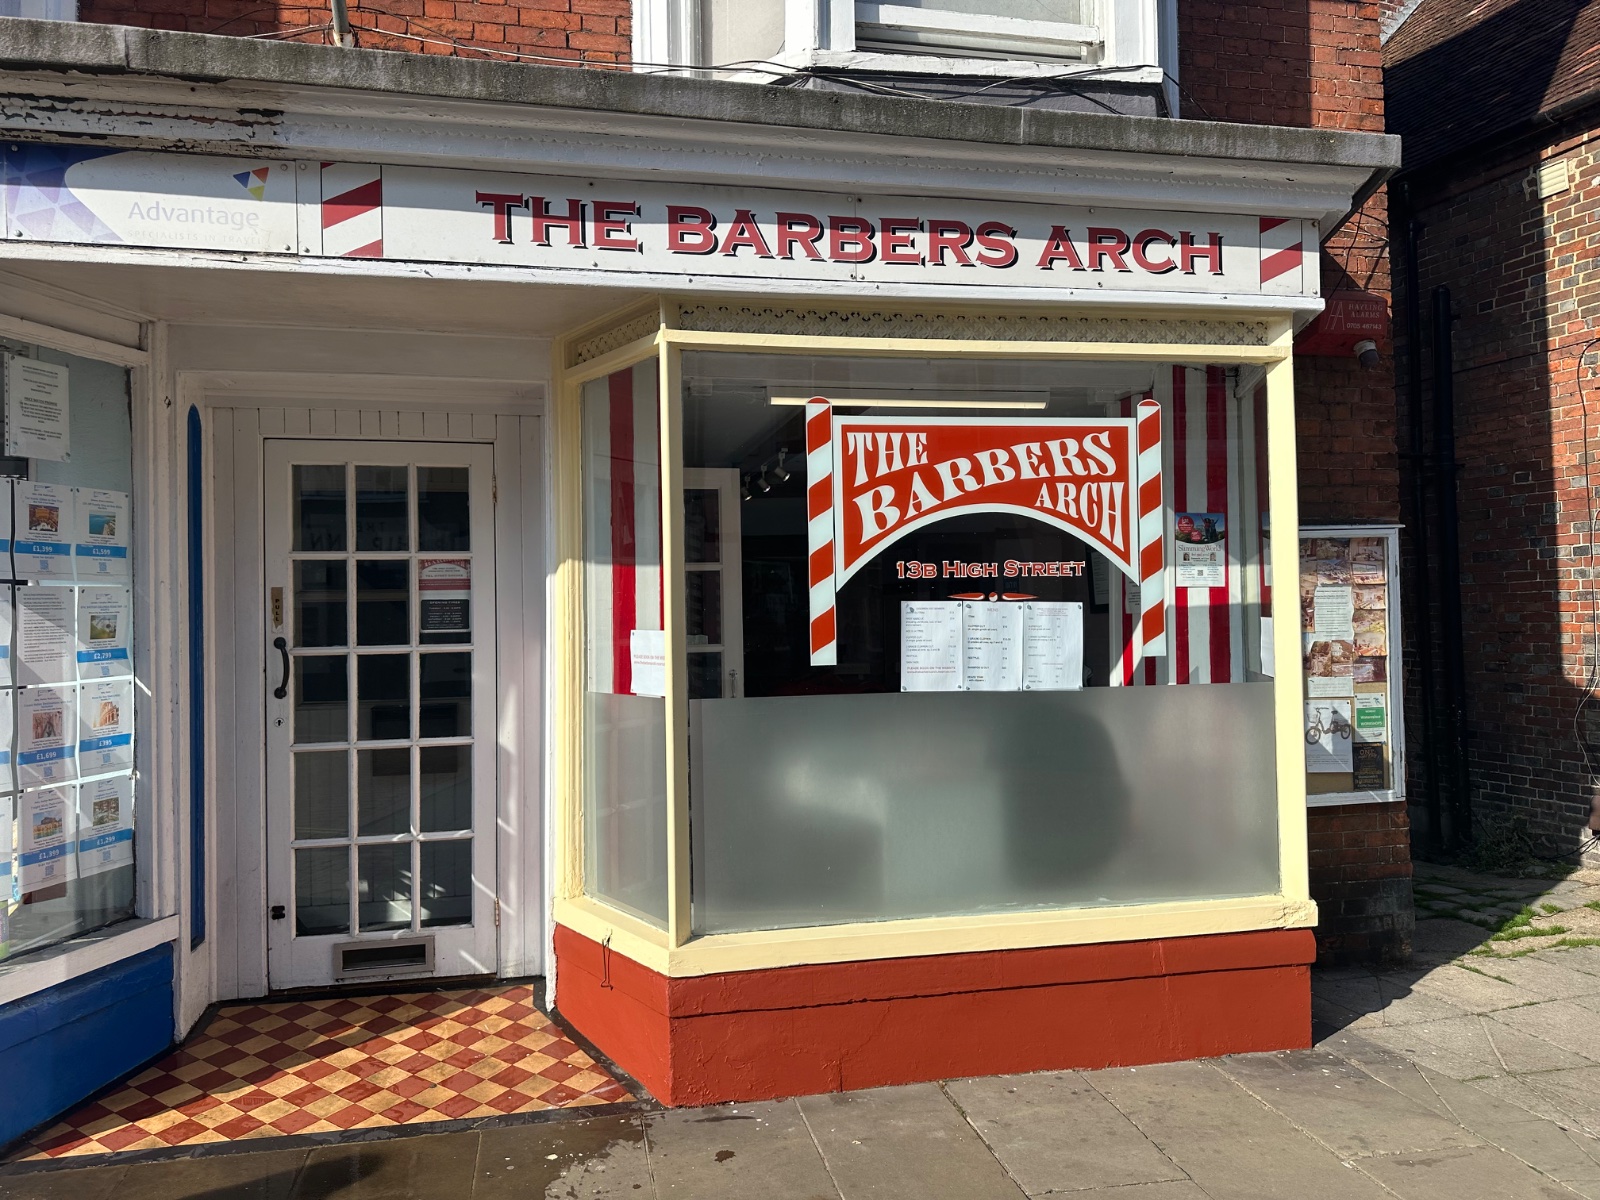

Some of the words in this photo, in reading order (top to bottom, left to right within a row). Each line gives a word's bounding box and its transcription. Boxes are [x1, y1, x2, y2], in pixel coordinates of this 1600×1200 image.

[127, 200, 259, 231] Advantage
[128, 230, 199, 241] SPECIALISTS
[475, 192, 643, 254] THE
[666, 206, 1020, 269] BARBERS
[1037, 225, 1225, 276] ARCH
[846, 431, 929, 488] THE
[852, 430, 1118, 545] BARBERS
[1034, 481, 1126, 553] ARCH
[896, 560, 938, 579] 13B
[942, 560, 998, 579] HIGH
[1003, 559, 1085, 578] STREET
[36, 751, 57, 760] £1,699
